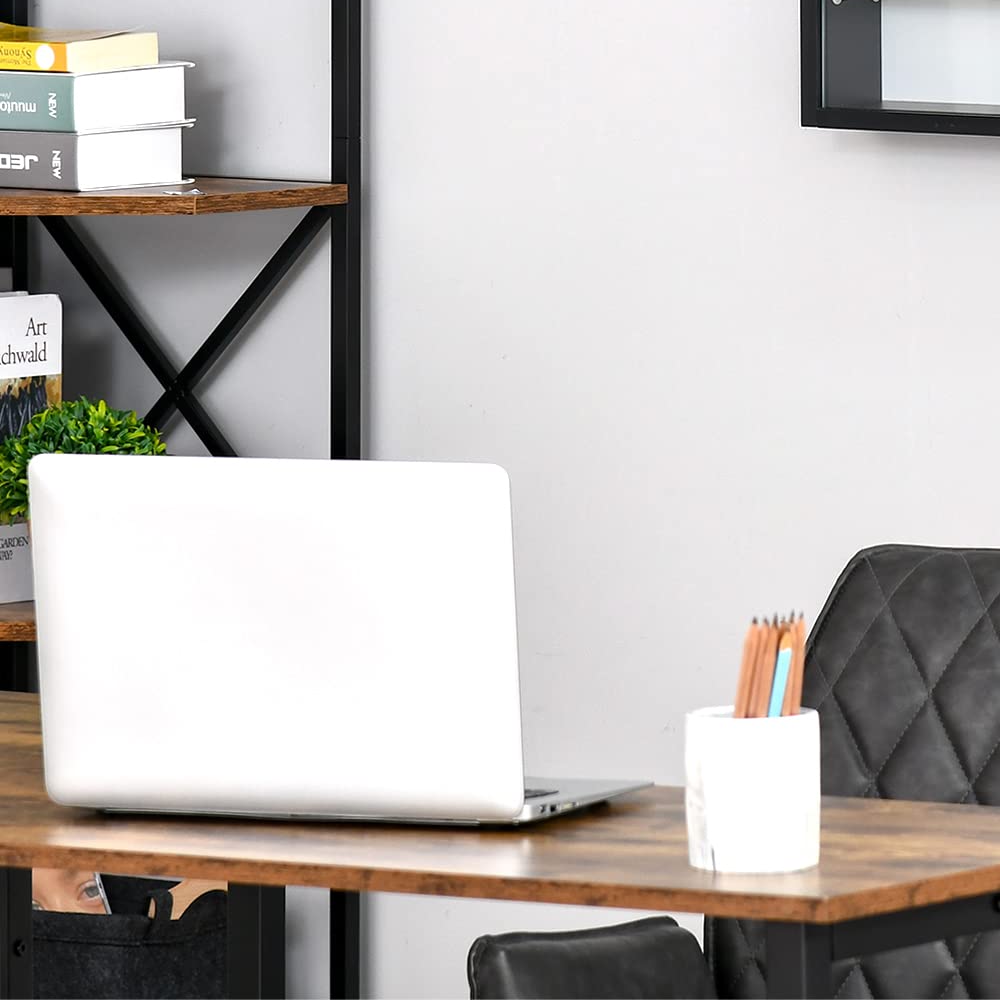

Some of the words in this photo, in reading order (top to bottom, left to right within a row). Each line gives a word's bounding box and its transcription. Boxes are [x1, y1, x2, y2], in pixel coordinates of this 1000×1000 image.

[0, 101, 37, 114] muuto
[48, 92, 57, 119] NEW
[52, 150, 62, 180] NEW
[25, 317, 48, 337] Art
[0, 341, 48, 366] chwald
